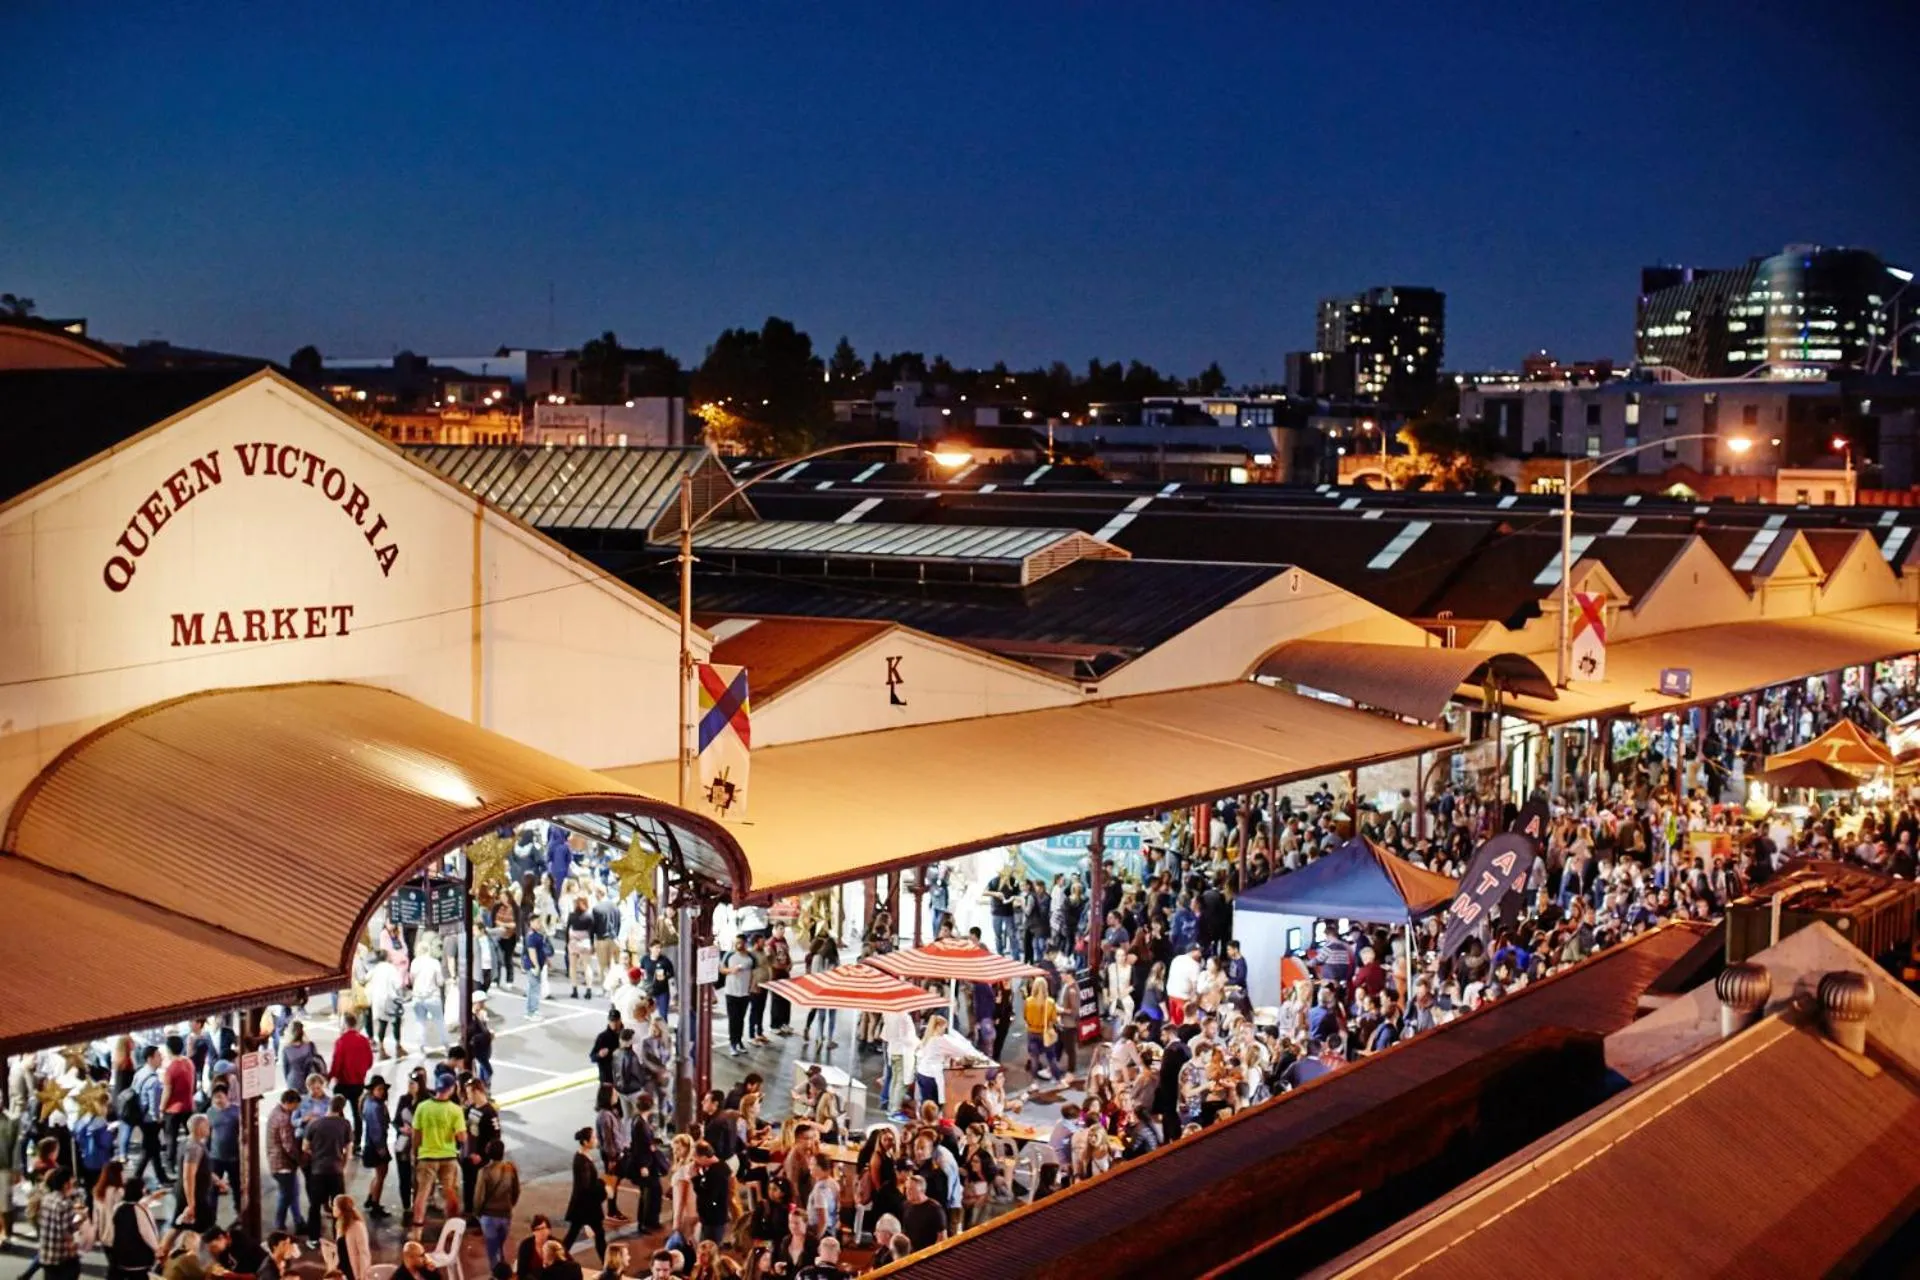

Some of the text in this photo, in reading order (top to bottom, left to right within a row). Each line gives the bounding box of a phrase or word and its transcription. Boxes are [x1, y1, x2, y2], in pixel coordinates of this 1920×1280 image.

[103, 442, 400, 592] QUEEN VICTORIA
[1291, 574, 1299, 592] J
[170, 604, 354, 646] MARKET
[885, 655, 904, 685] K
[1450, 851, 1517, 924] ATM
